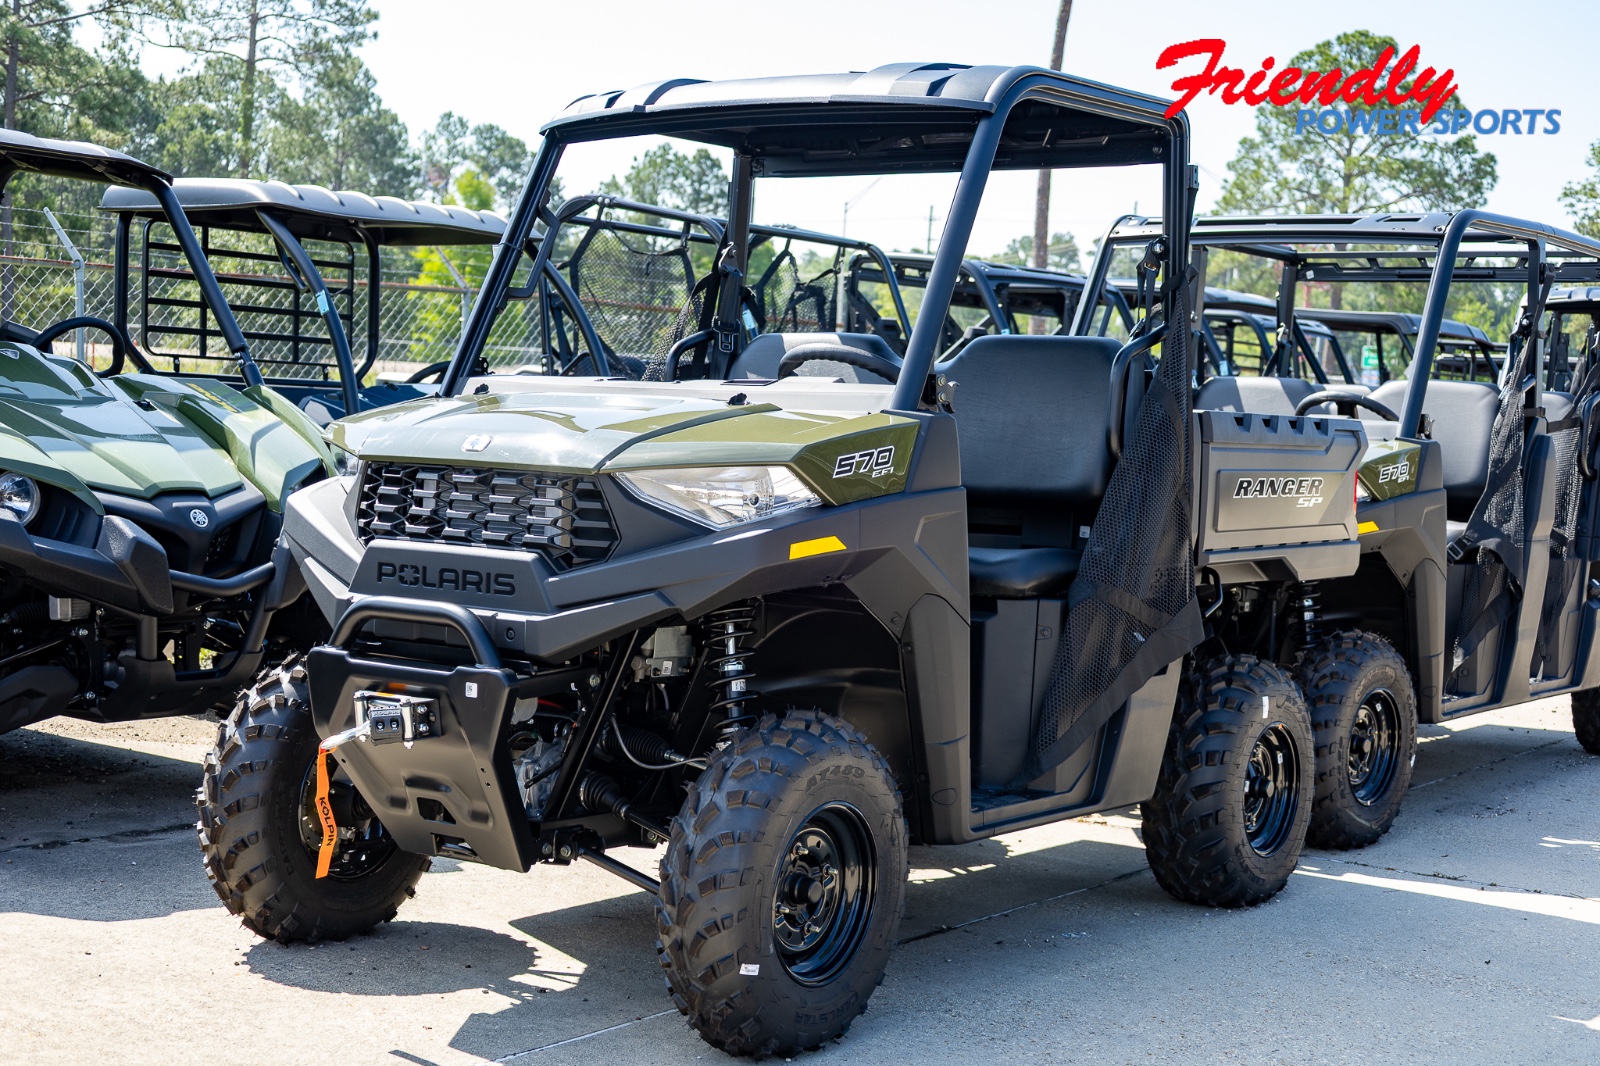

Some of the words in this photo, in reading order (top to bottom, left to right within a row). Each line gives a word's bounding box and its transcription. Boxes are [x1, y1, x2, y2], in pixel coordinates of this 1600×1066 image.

[832, 445, 895, 478] 570
[871, 466, 895, 478] EFI
[1379, 461, 1410, 483] 570
[1232, 476, 1325, 498] RANGER
[1295, 496, 1324, 508] SP
[376, 561, 517, 597] POLARIS
[804, 765, 866, 793] AT489
[318, 796, 337, 847] KOLPIN
